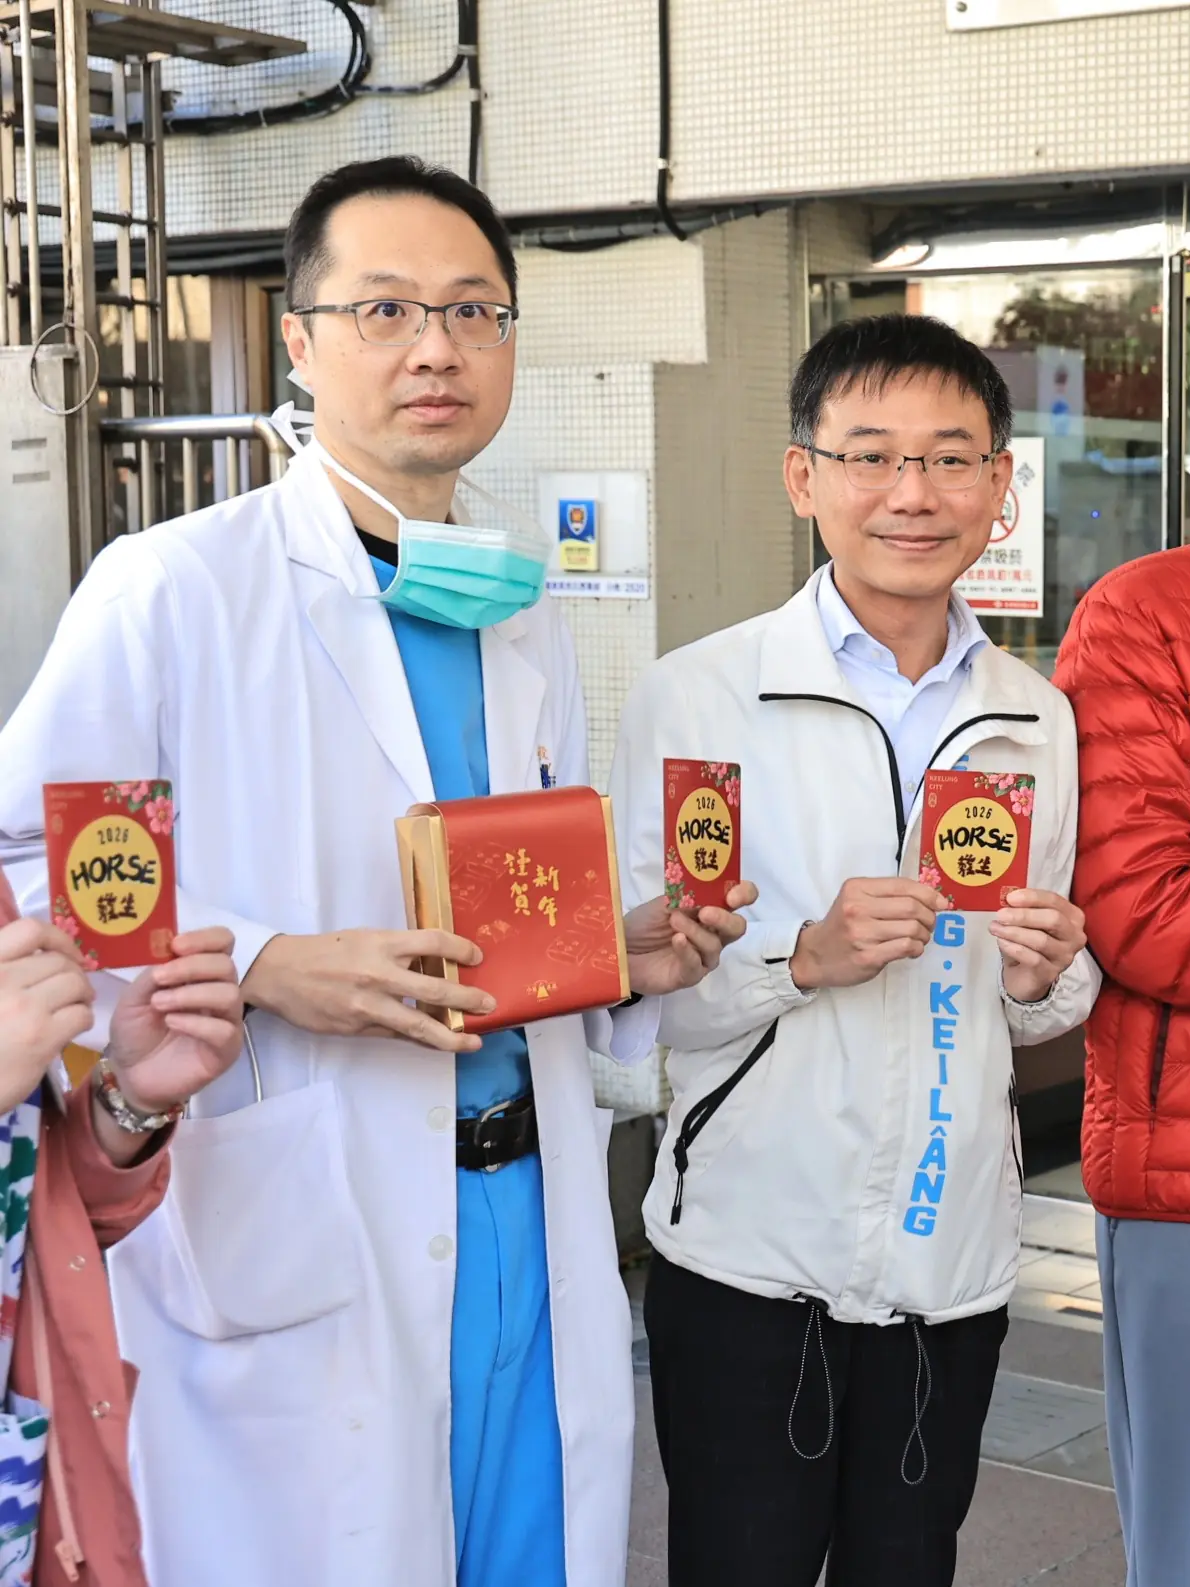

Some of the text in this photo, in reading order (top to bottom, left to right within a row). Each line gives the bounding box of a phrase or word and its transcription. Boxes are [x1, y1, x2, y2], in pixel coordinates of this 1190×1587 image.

[696, 796, 716, 810] 2026
[964, 806, 993, 819] 2026
[97, 826, 130, 845] 2026
[678, 817, 731, 846] HORSE
[938, 826, 1014, 853] HORSE
[70, 853, 157, 892] HORSE
